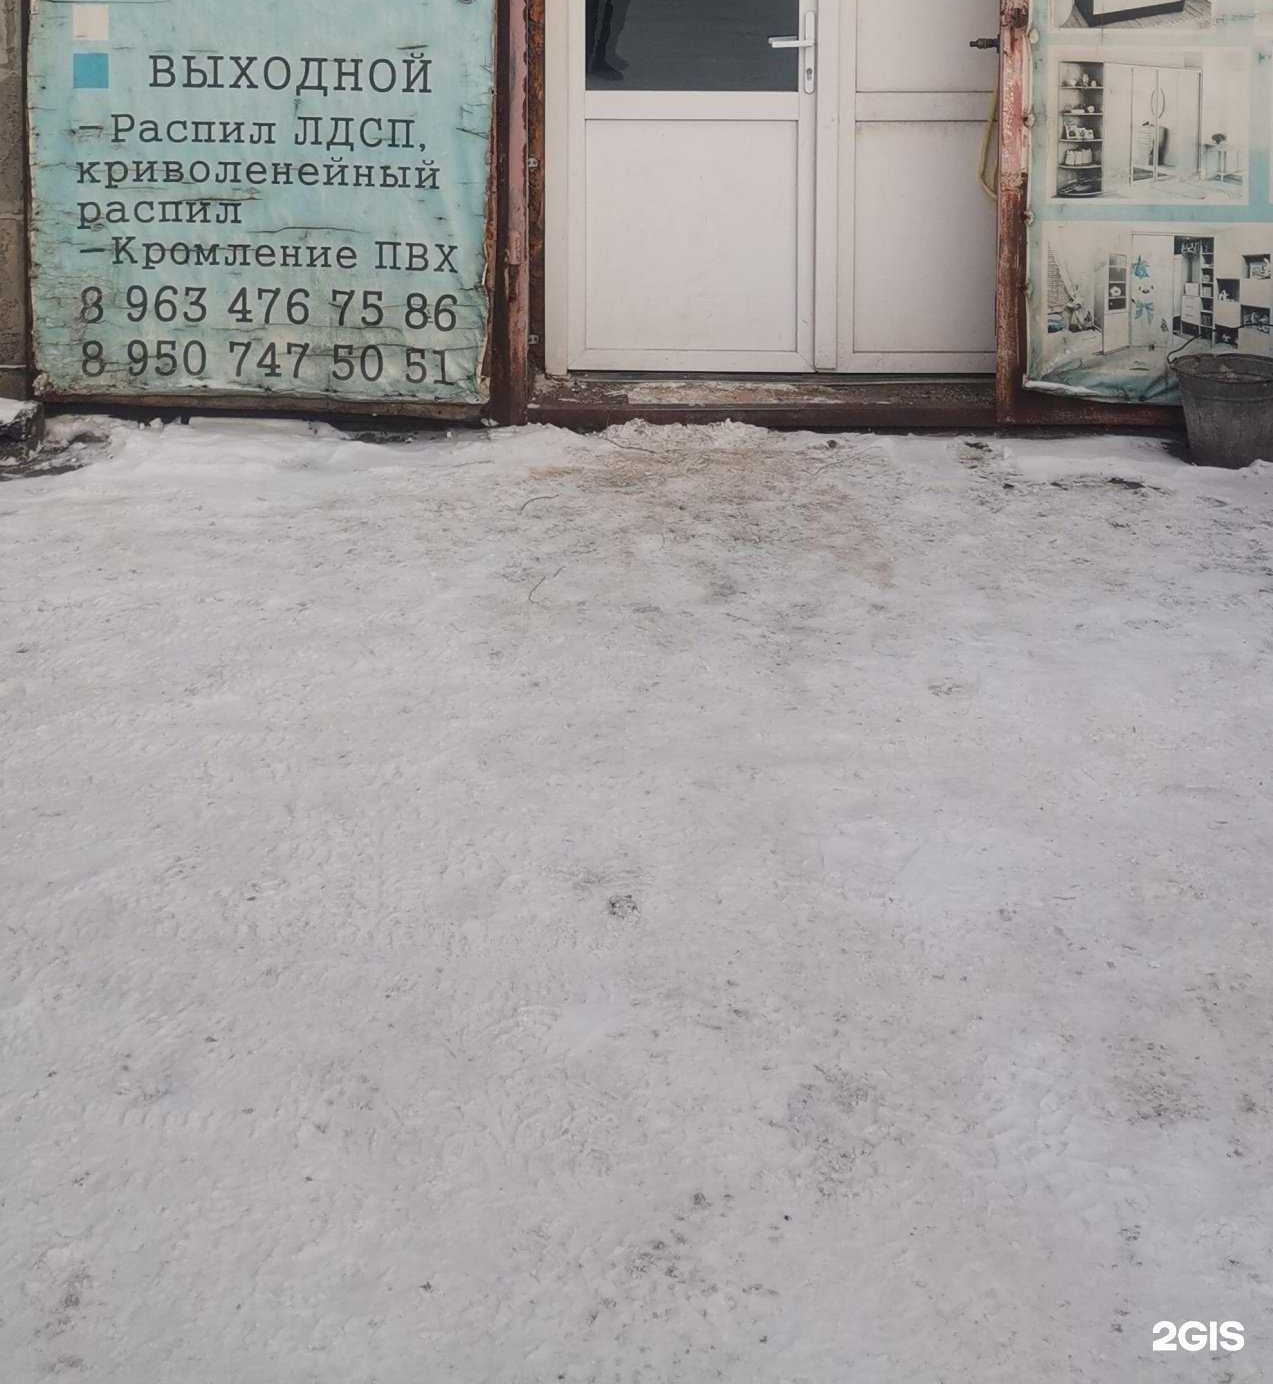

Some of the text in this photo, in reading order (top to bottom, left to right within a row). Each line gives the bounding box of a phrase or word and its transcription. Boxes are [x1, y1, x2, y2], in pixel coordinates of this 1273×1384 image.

[149, 52, 432, 97] ВЫХОДНОЙ
[294, 115, 427, 152] ЛДСП,
[76, 158, 440, 190] криволенейный
[76, 198, 243, 229] распил
[374, 241, 459, 273] ПВХ
[80, 285, 458, 332] 8 963 476 75 86
[81, 340, 456, 386] 8 950 747 50 51
